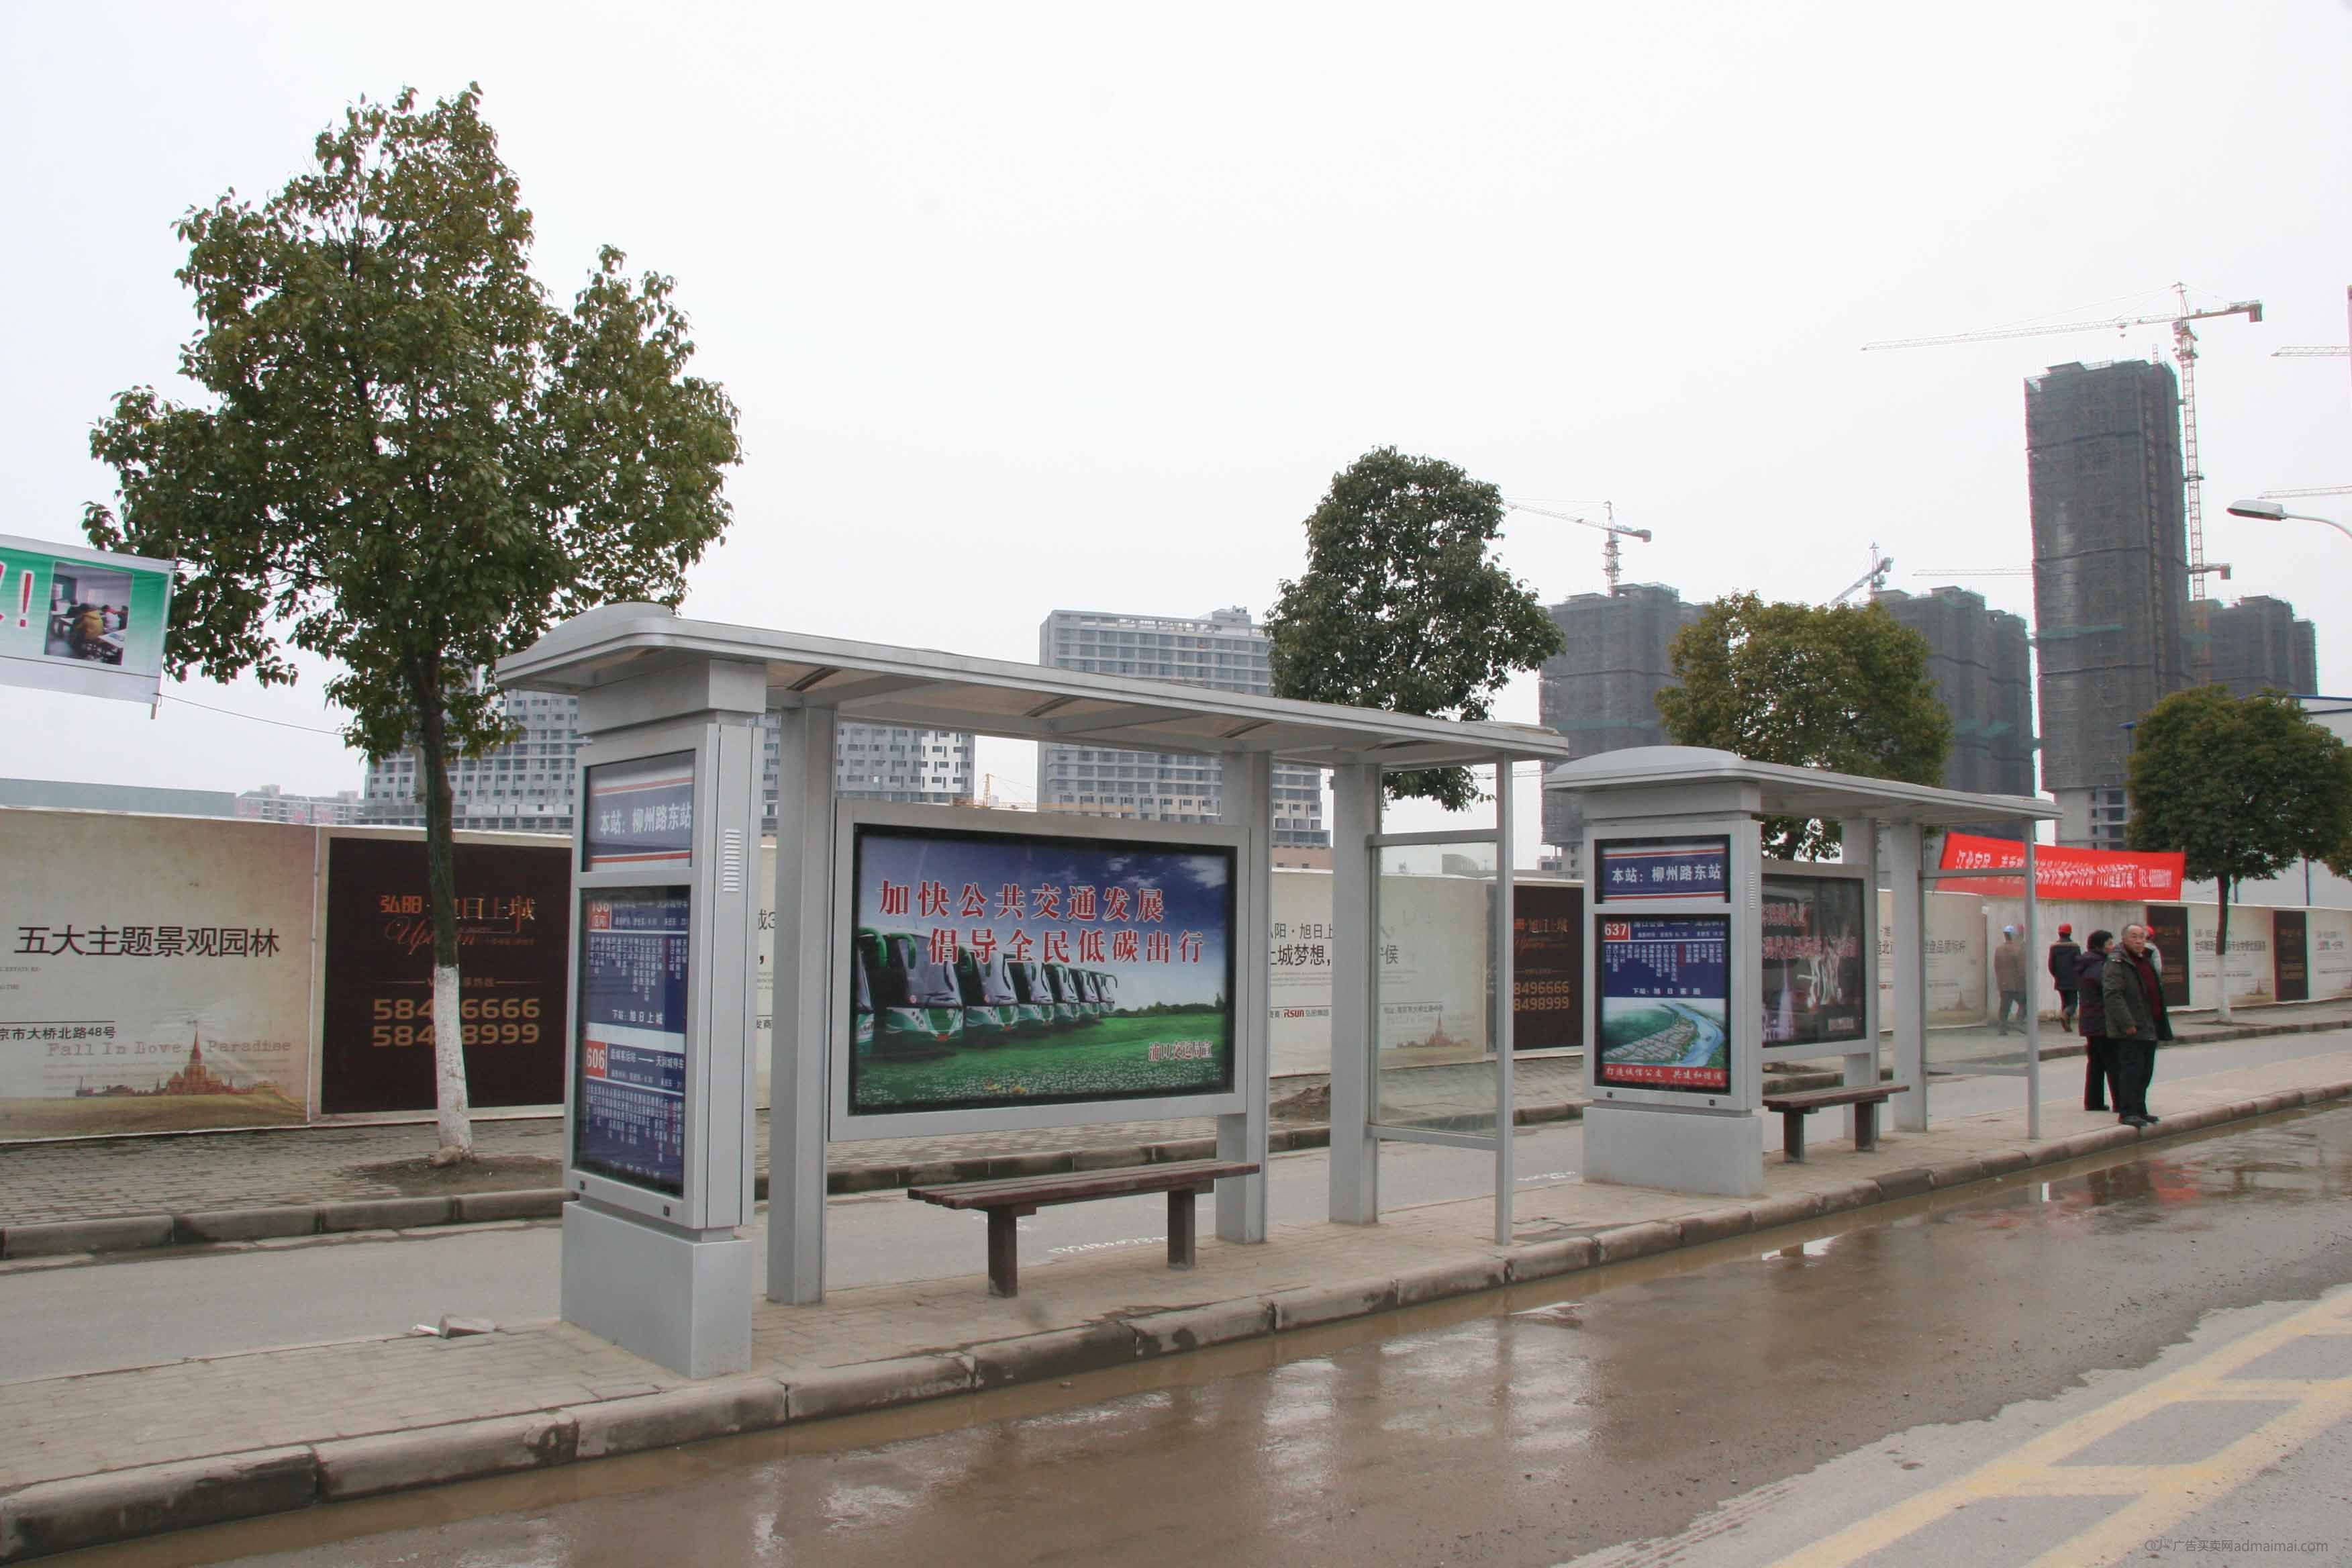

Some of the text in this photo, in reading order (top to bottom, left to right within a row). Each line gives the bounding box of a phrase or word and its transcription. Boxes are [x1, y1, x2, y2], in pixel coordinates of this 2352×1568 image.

[877, 879, 1165, 922] 加快公共交通发展
[1604, 923, 1627, 936] 637
[14, 924, 281, 959] 五大主题景观园林
[927, 928, 1205, 965] 倡导全民低碳出行
[373, 998, 540, 1020] 5846666
[373, 1024, 540, 1046] 5848999
[585, 1047, 605, 1069] 606
